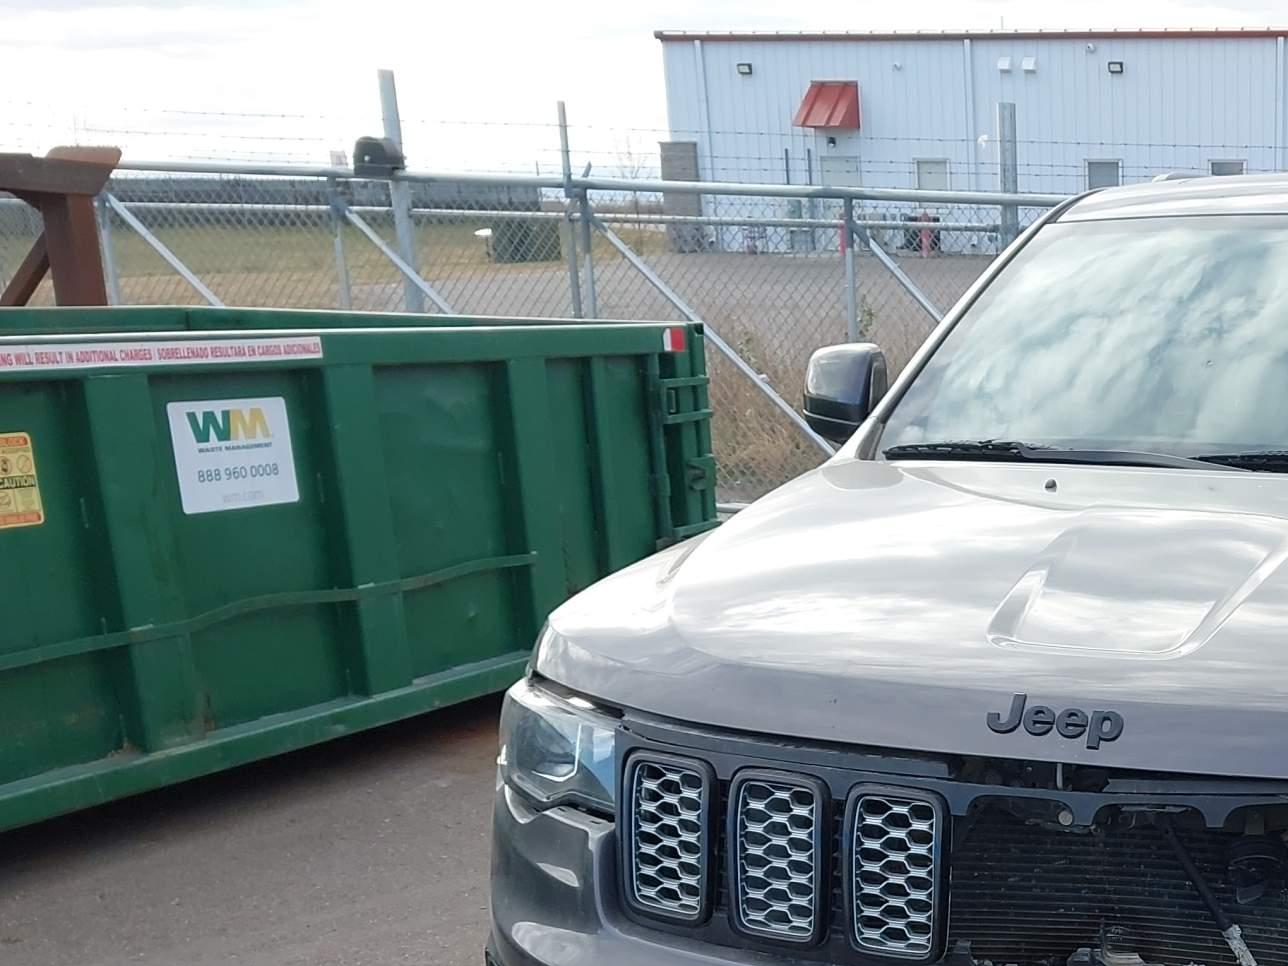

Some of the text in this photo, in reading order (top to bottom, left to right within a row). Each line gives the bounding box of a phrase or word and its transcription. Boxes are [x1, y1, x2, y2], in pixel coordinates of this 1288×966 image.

[14, 351, 34, 366] WILL
[35, 351, 64, 365] RESULT
[65, 350, 74, 363] IN
[75, 349, 119, 363] ADDITIONAL
[119, 348, 153, 362] CHARGES
[185, 407, 273, 444] WM
[197, 442, 273, 454] WASTE MANAGEMENT
[197, 462, 280, 484] 888 960 0008
[986, 691, 1124, 750] Jeep
